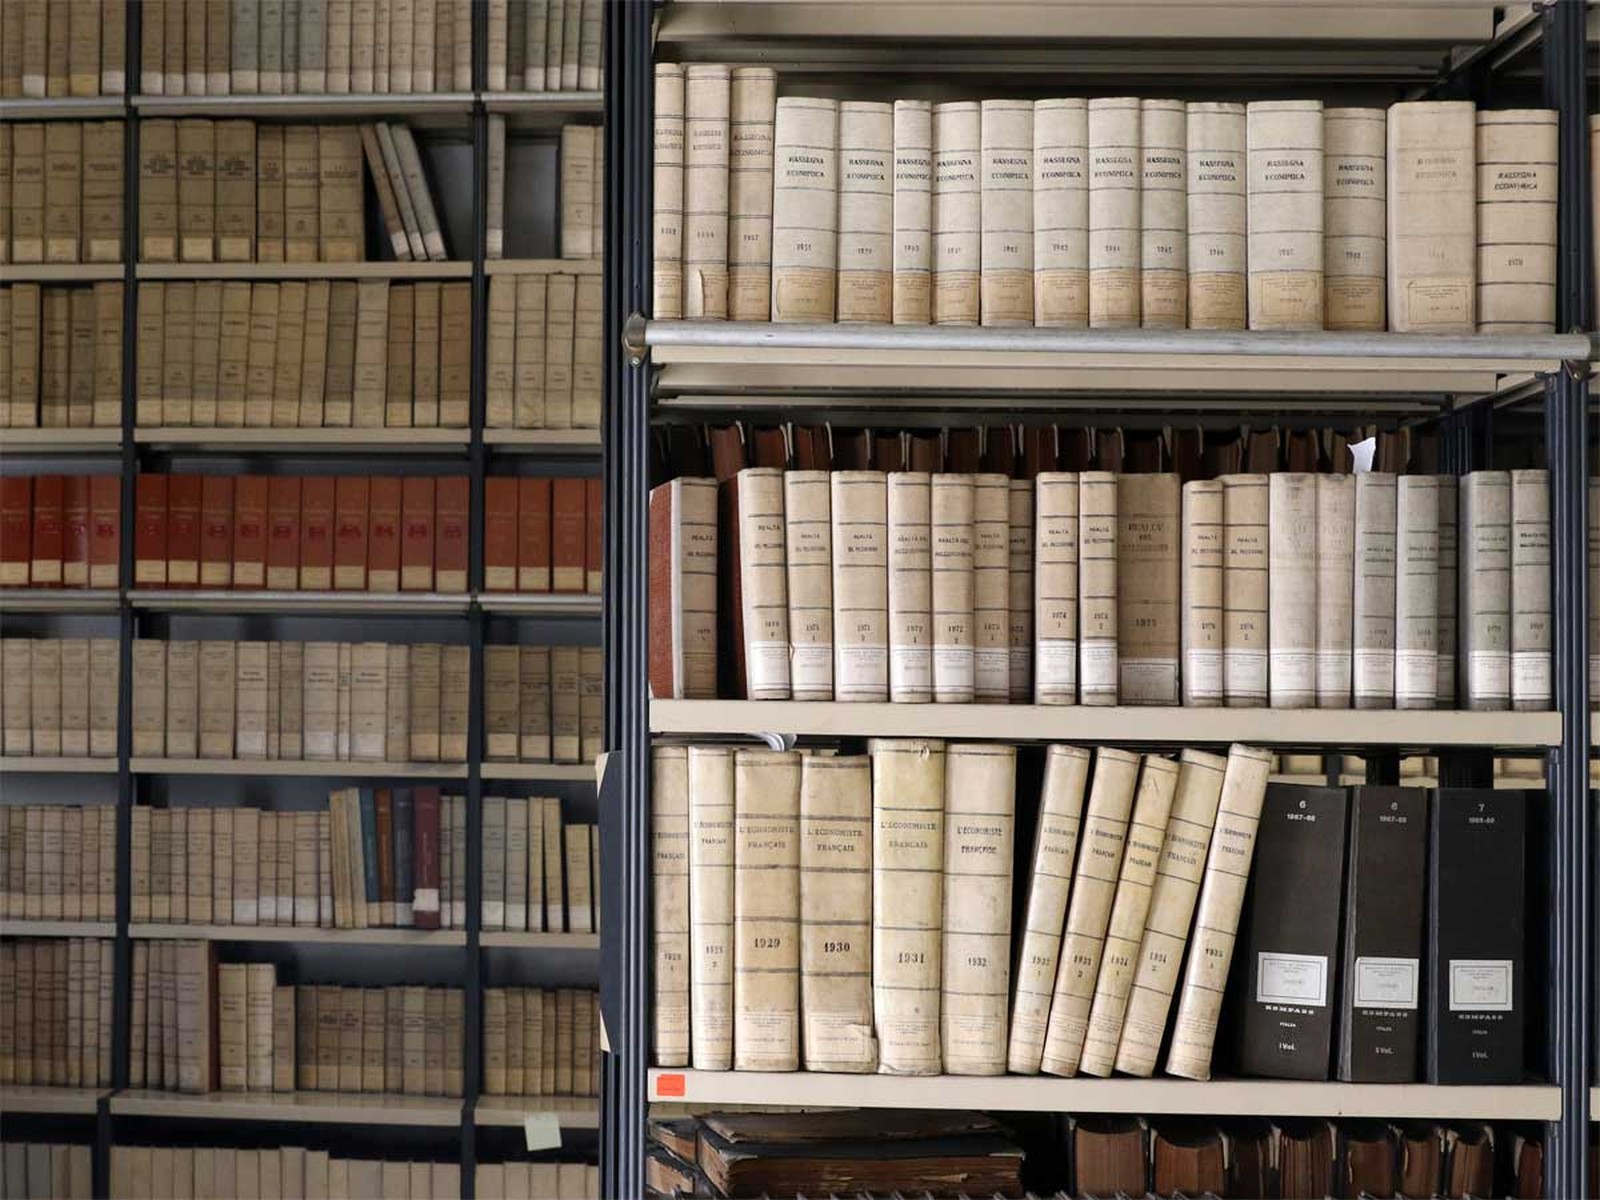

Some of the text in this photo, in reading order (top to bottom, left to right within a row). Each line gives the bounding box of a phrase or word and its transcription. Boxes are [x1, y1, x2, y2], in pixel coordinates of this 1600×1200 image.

[849, 159, 884, 167] RASSEGNA
[993, 158, 1028, 166] RASSEGNA
[1043, 157, 1081, 165] RASSEGNA
[1096, 157, 1132, 165] RASSEGNA
[1147, 157, 1181, 165] RASSEGNA
[1042, 171, 1081, 179] ECONOMICA
[1094, 170, 1134, 178] ECONOMICA
[1145, 171, 1182, 179] ECONOMICA
[1199, 174, 1236, 182] ECONOMICA
[1265, 173, 1305, 181] ECONOMICA
[754, 937, 781, 948] 1929
[824, 942, 850, 952] 1930
[898, 953, 925, 963] 1931
[968, 956, 987, 967] 1932
